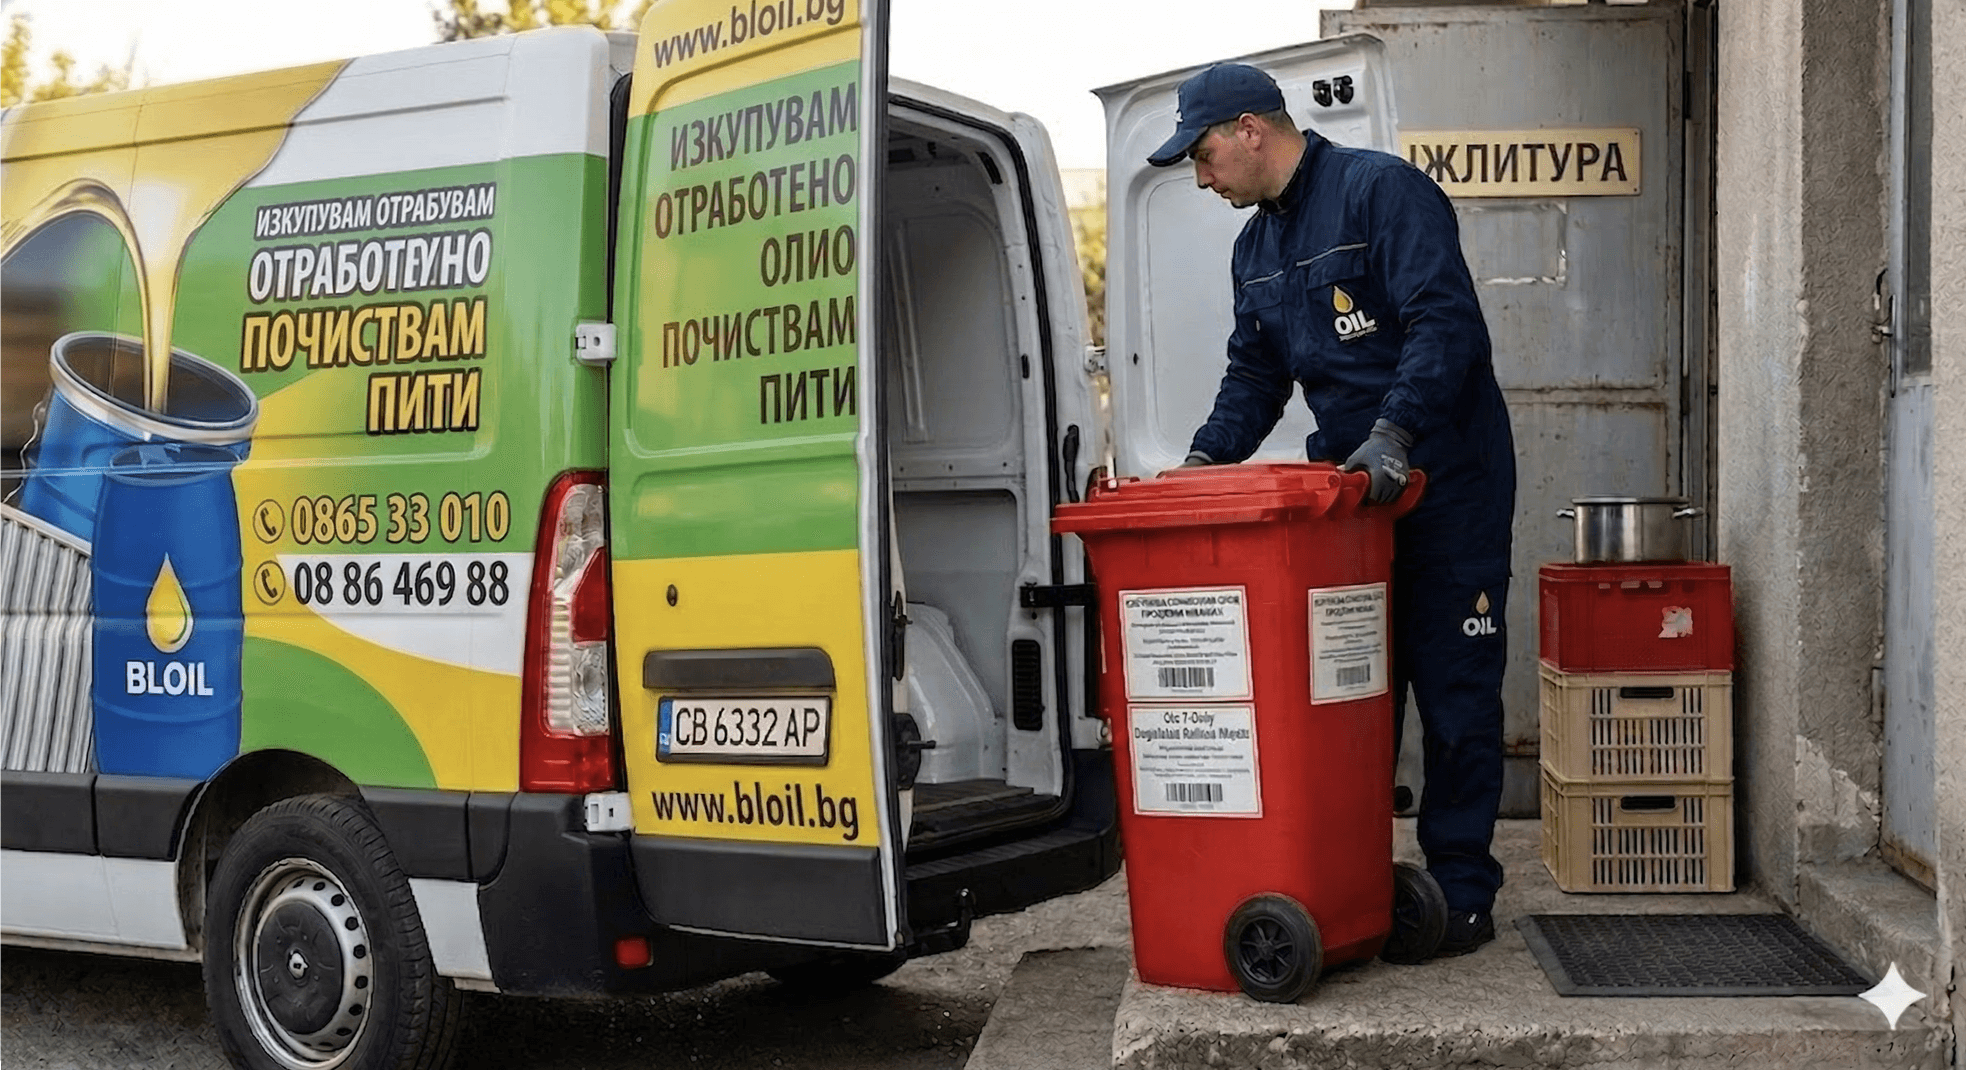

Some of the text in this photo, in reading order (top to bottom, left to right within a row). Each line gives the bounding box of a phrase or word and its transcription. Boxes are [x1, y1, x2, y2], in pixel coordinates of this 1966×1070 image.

[671, 82, 857, 171] ИЗКУПУВАМ
[255, 185, 495, 238] ИЗКУПУВАМ ОТРАБУВАМ
[655, 153, 856, 239] ОТРАБОТЕНО
[760, 224, 856, 287] ОЛИО
[242, 300, 486, 369] ПОЧИСТВАМ
[663, 295, 856, 368] ПОЧИСТВАМ
[1334, 309, 1376, 335] OIL
[368, 371, 480, 432] ПИТИ
[760, 365, 856, 425] ПИТИ
[292, 490, 511, 545] 0865 33 010
[294, 561, 509, 606] 08 86 469 88
[1462, 616, 1497, 637] OIL
[126, 660, 214, 696] BLOIL
[714, 707, 778, 746] 6332
[651, 780, 859, 841] www.bloil.bg
